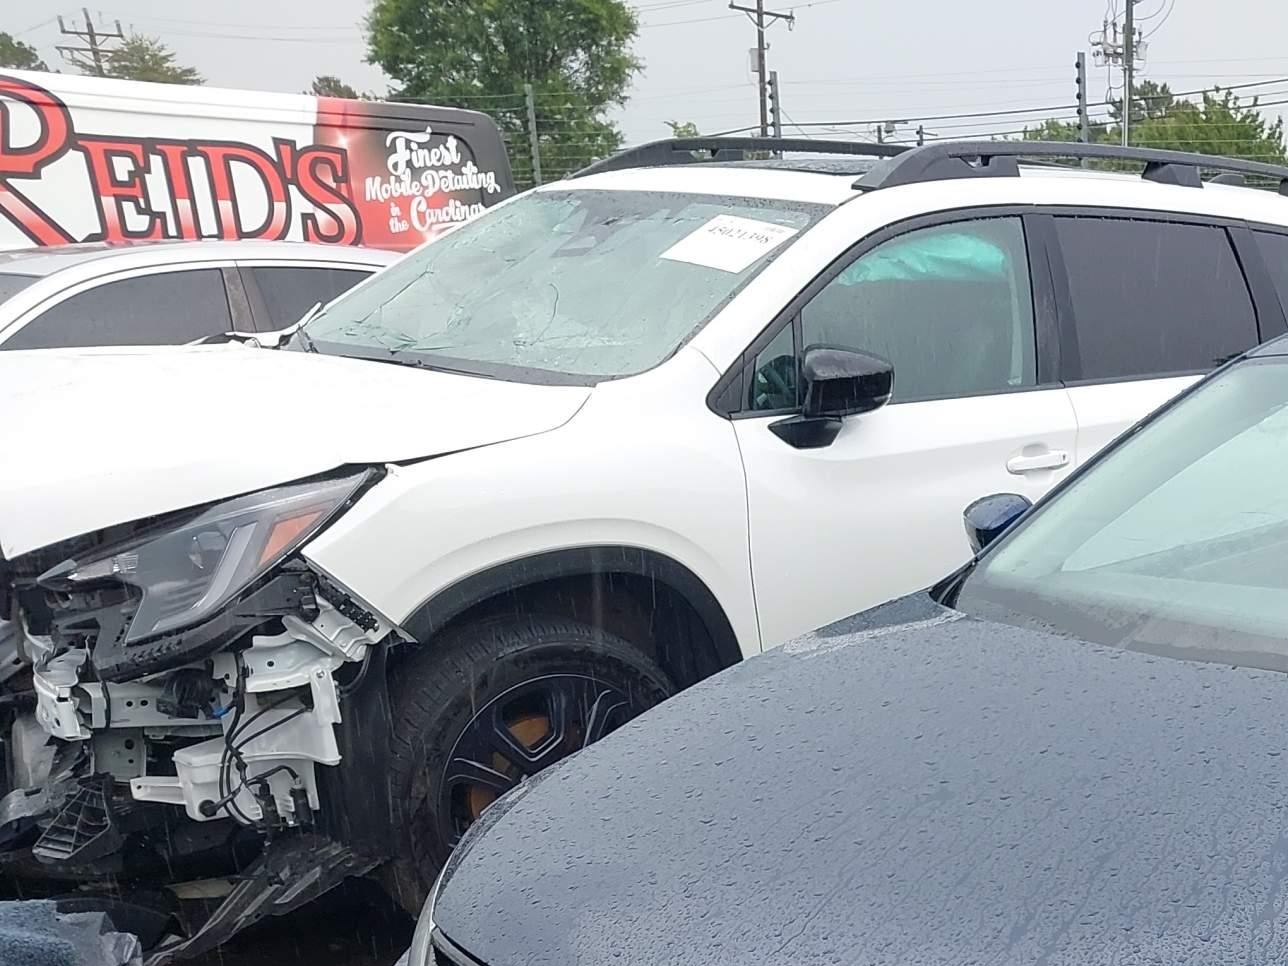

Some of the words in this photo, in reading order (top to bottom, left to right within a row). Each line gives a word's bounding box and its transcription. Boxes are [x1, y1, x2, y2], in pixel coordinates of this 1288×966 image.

[386, 126, 461, 177] Finest
[365, 168, 423, 202] Mobile
[421, 160, 500, 198] Detailing
[390, 202, 401, 217] in
[389, 218, 409, 234] the
